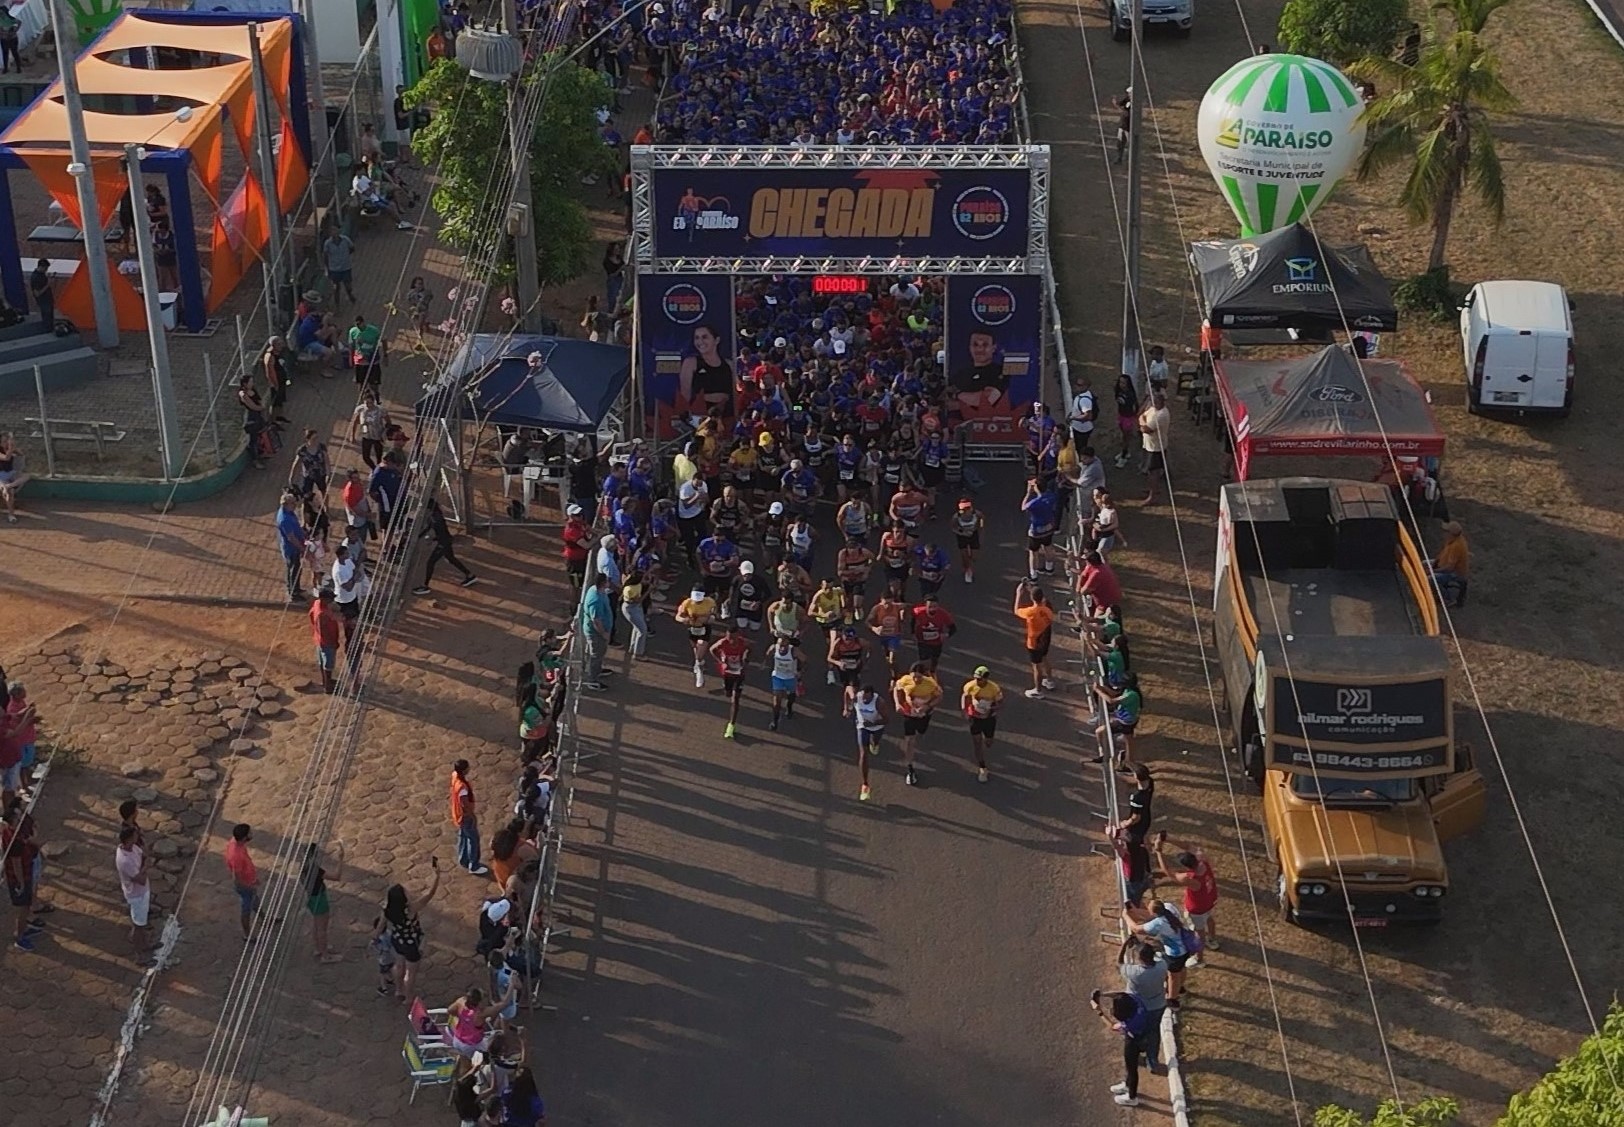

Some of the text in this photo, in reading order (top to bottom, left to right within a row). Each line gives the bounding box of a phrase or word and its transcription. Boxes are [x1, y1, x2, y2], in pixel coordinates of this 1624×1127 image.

[1218, 161, 1255, 175] ESPORTE
[1265, 170, 1326, 179] JUVENTUDE
[749, 188, 935, 238] CHEGADA
[1319, 385, 1354, 401] Ford
[1351, 713, 1424, 726] rodrigues
